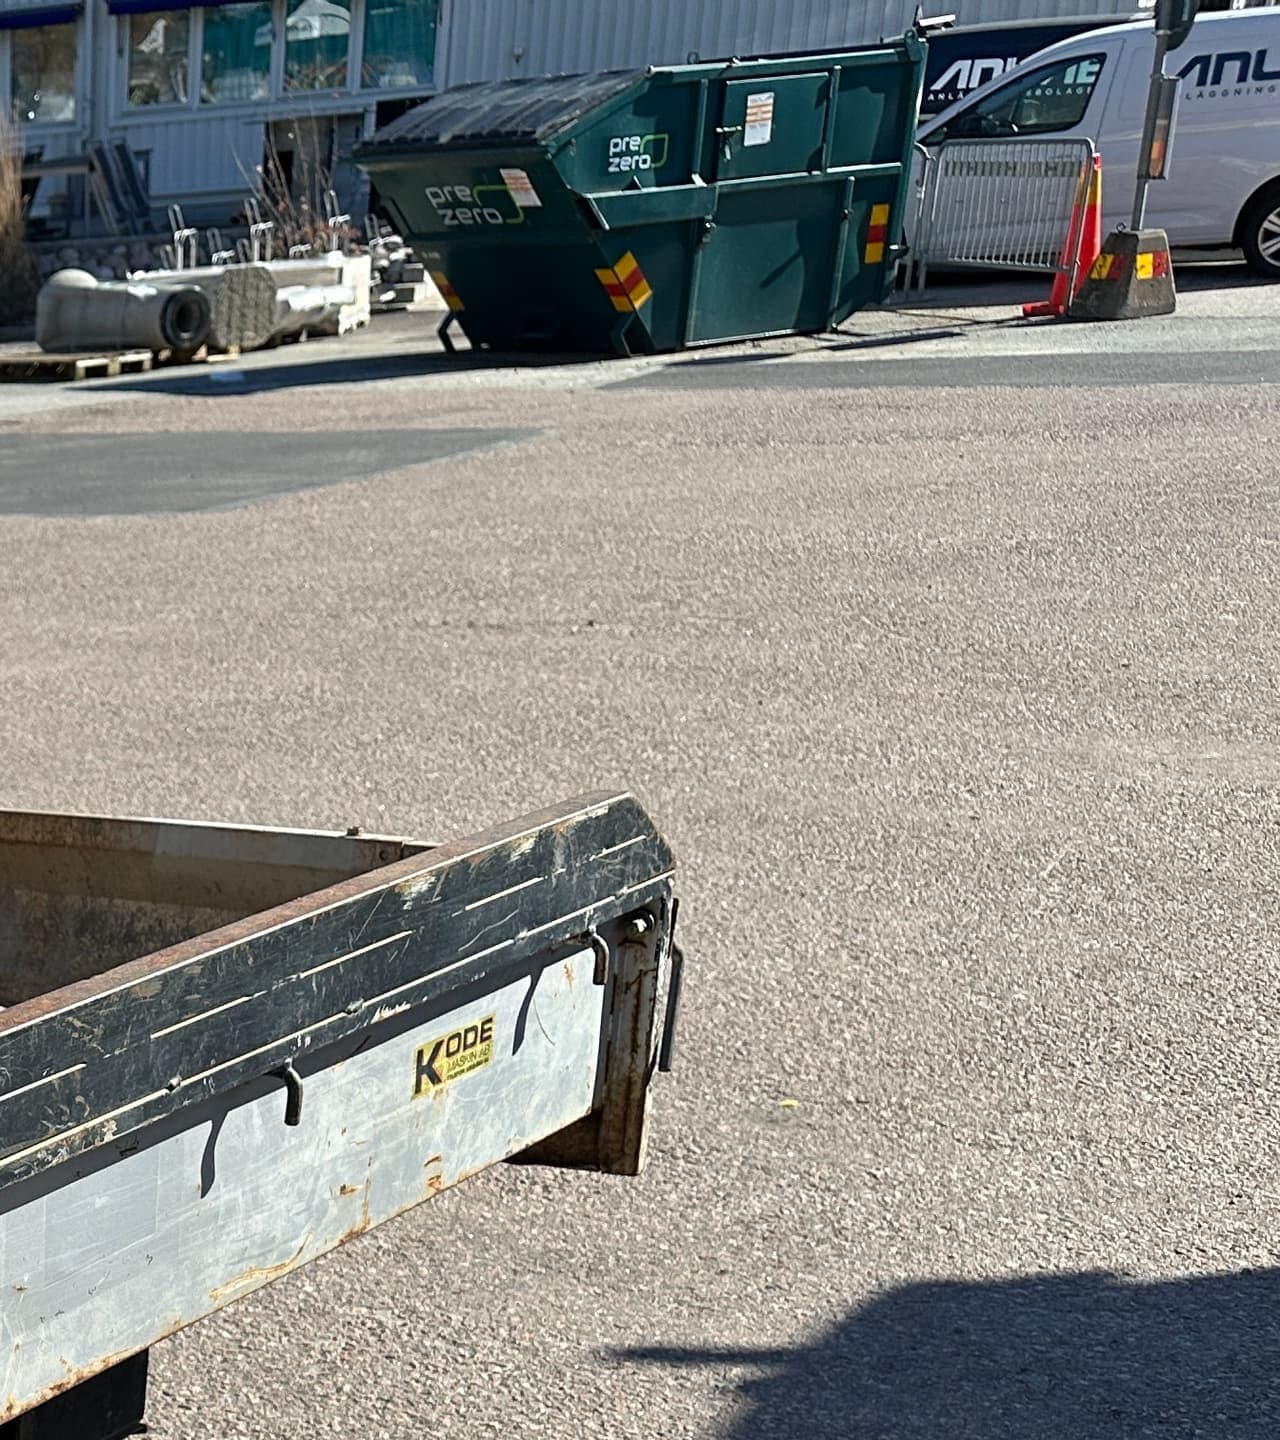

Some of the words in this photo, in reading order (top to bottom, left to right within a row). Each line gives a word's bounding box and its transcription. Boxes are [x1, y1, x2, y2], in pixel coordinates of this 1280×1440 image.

[609, 135, 641, 157] pre
[608, 154, 652, 173] zero
[425, 185, 473, 209] pre
[437, 207, 504, 225] zero
[414, 1016, 494, 1095] KODE
